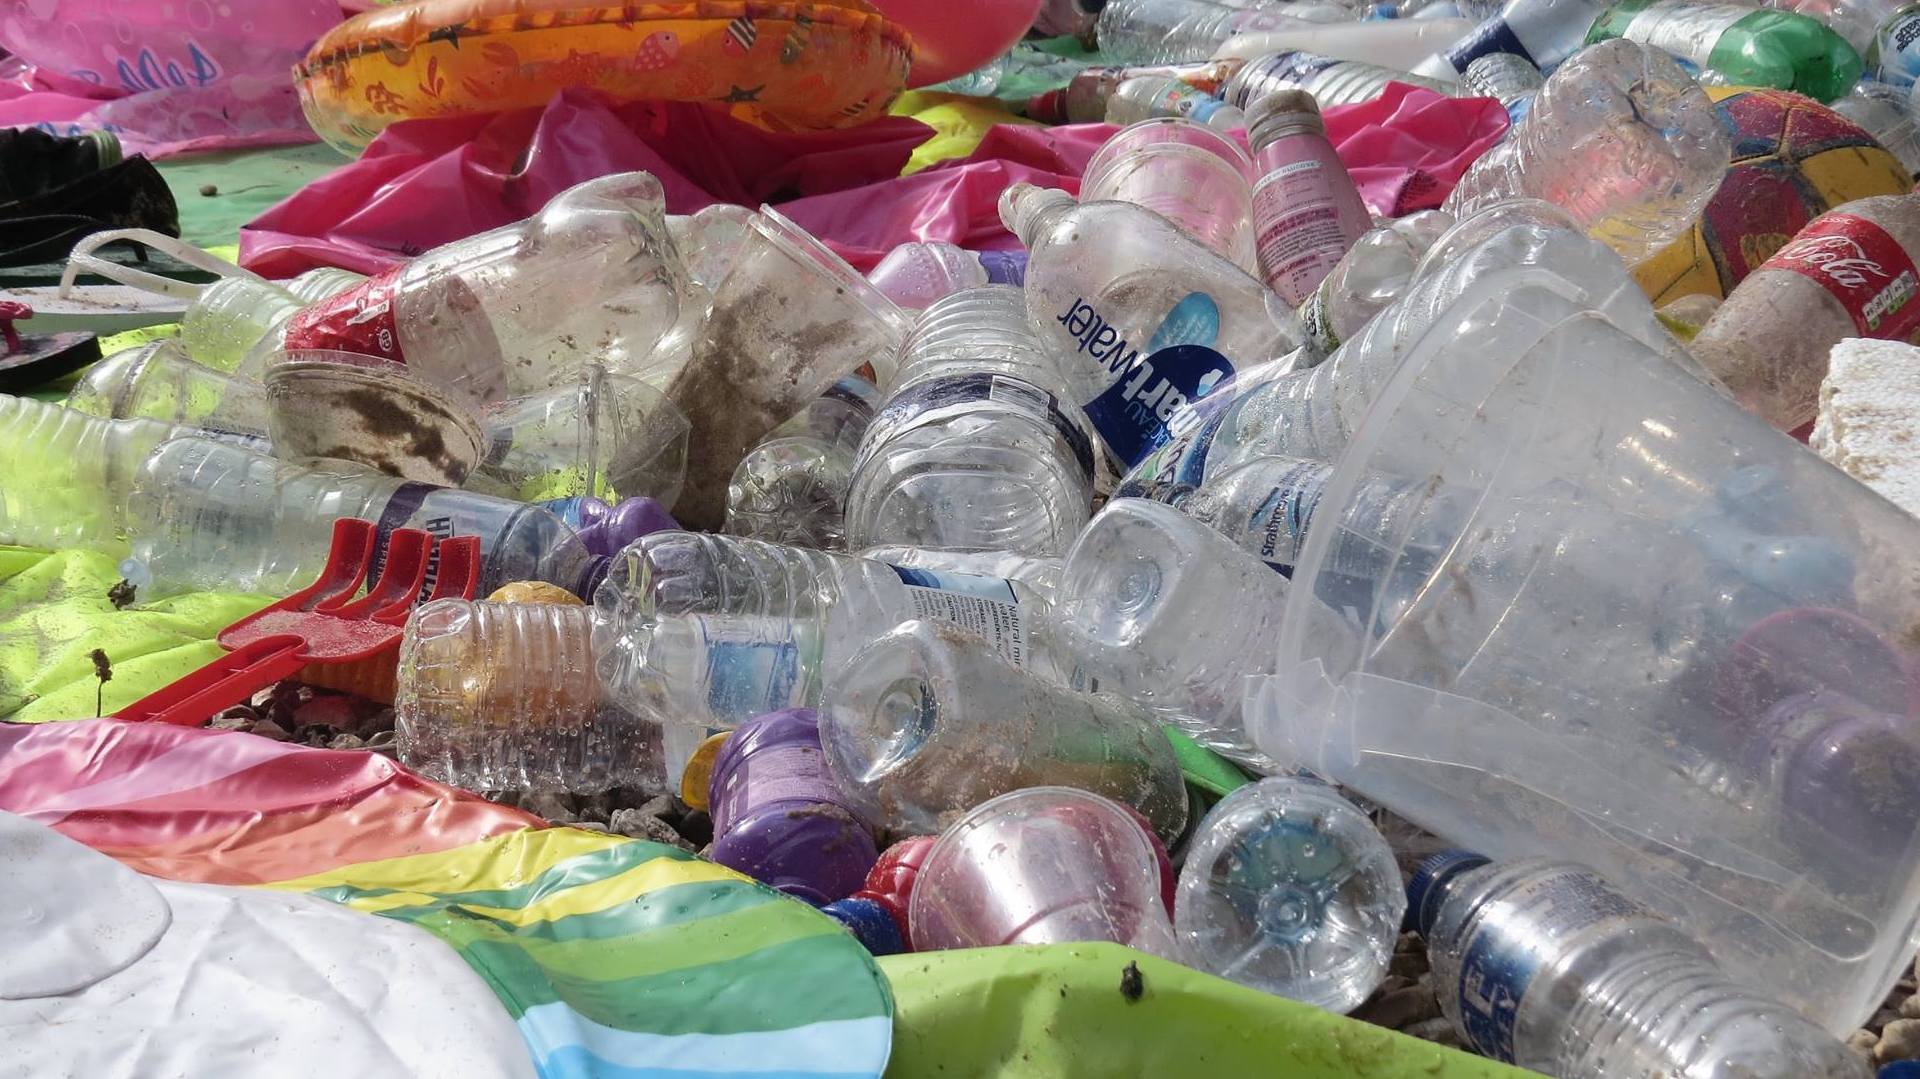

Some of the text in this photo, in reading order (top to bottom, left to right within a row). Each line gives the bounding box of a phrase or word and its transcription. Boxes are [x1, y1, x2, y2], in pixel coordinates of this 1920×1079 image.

[1783, 235, 1892, 289] Cola
[1056, 297, 1202, 438] martwater
[1260, 488, 1290, 558] Strathmore
[945, 596, 956, 622] CAUTION
[1007, 604, 1021, 643] Natural
